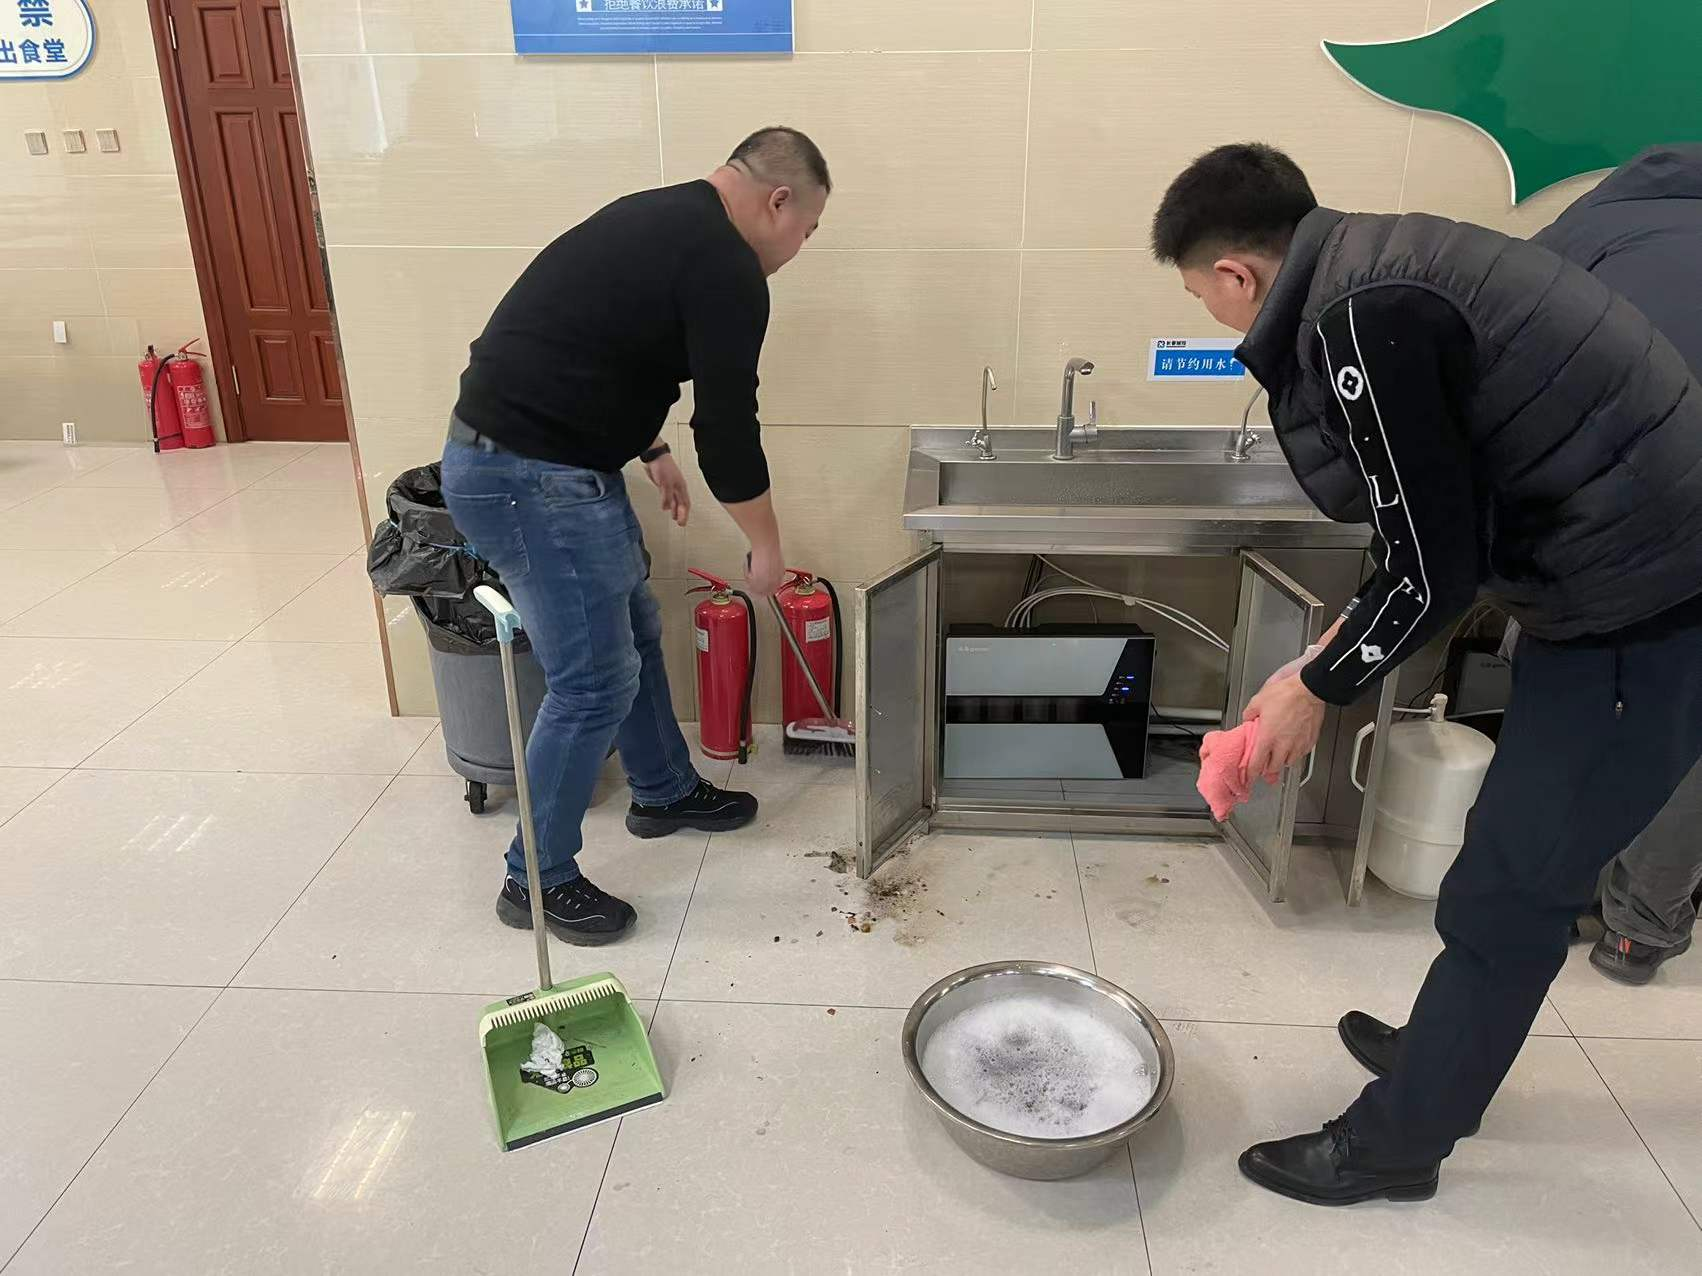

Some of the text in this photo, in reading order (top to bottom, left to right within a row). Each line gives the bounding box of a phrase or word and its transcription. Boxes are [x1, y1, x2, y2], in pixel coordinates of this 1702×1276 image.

[17, 0, 53, 27] 禁
[0, 38, 68, 64] 出食堂
